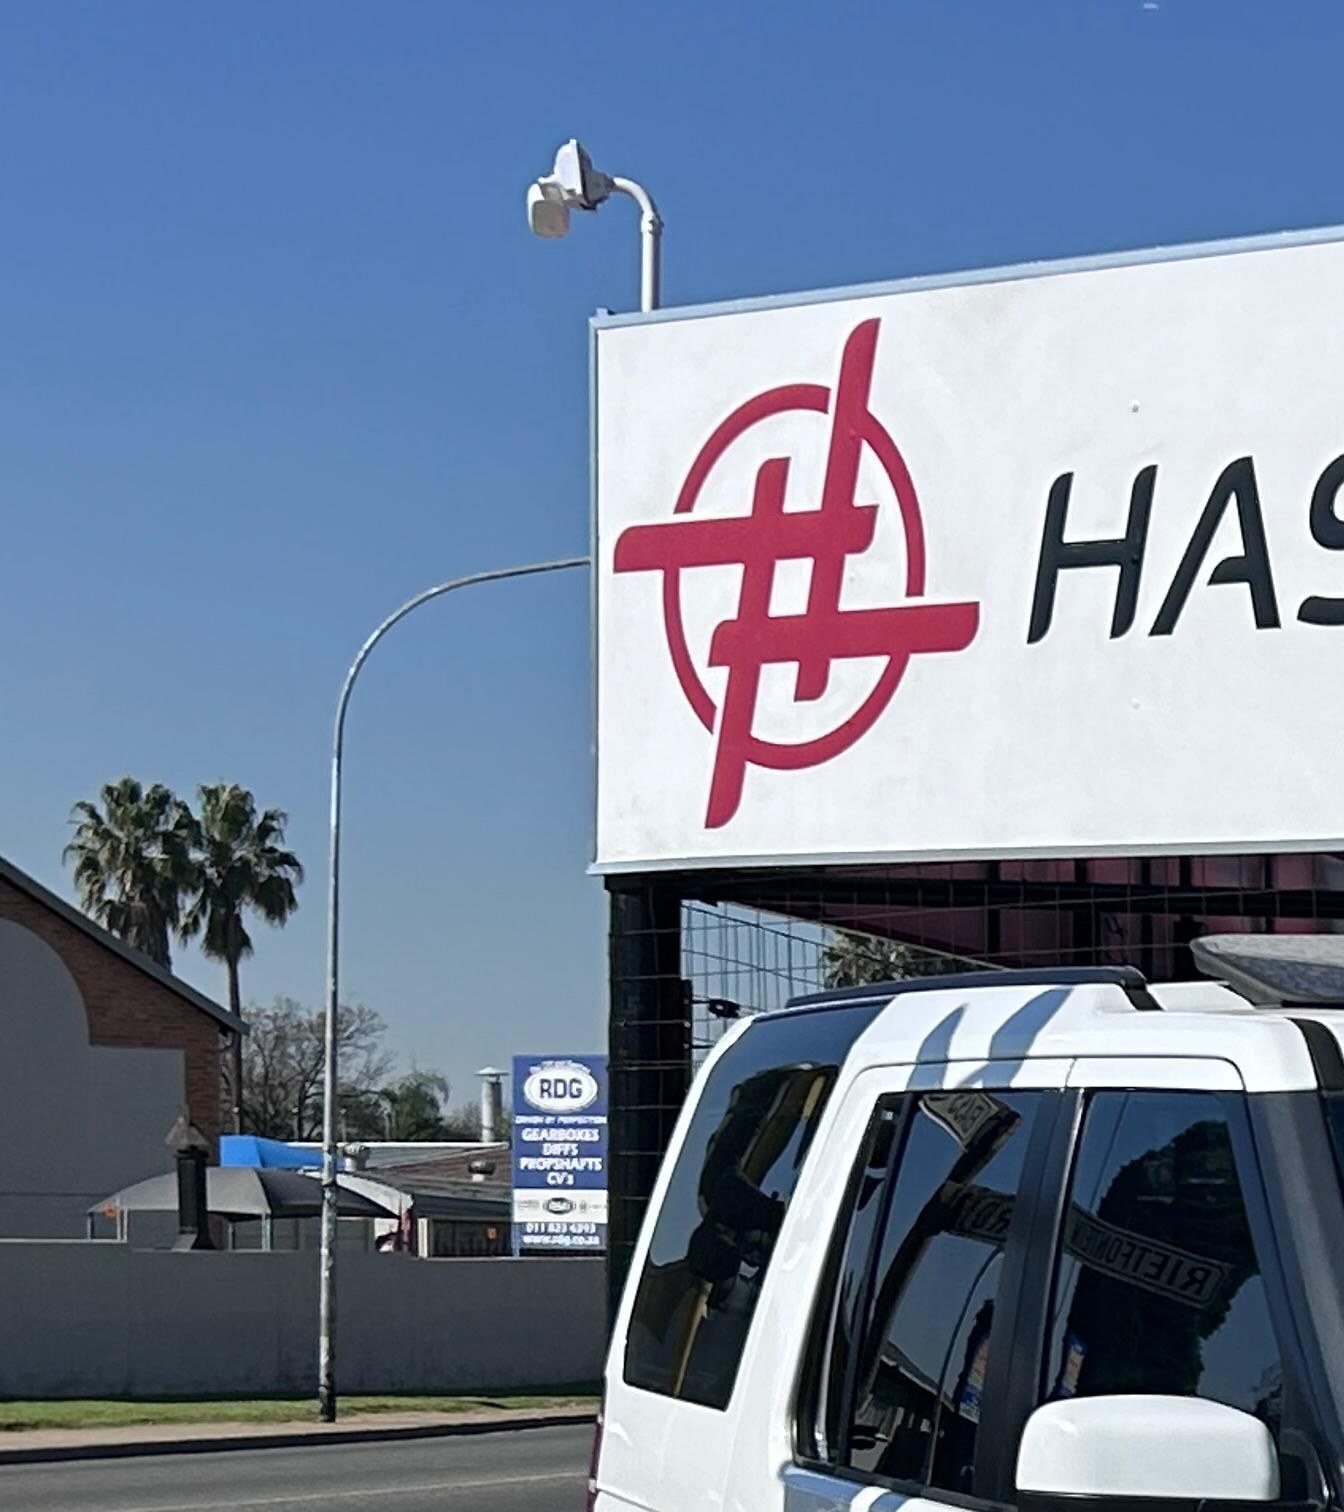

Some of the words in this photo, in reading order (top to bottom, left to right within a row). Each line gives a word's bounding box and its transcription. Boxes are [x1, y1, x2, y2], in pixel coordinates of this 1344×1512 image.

[539, 1078, 583, 1099] RDG
[521, 1128, 600, 1141] GEARBOXES
[542, 1143, 579, 1156] DIFFS
[519, 1157, 602, 1171] PROPSHAFTS
